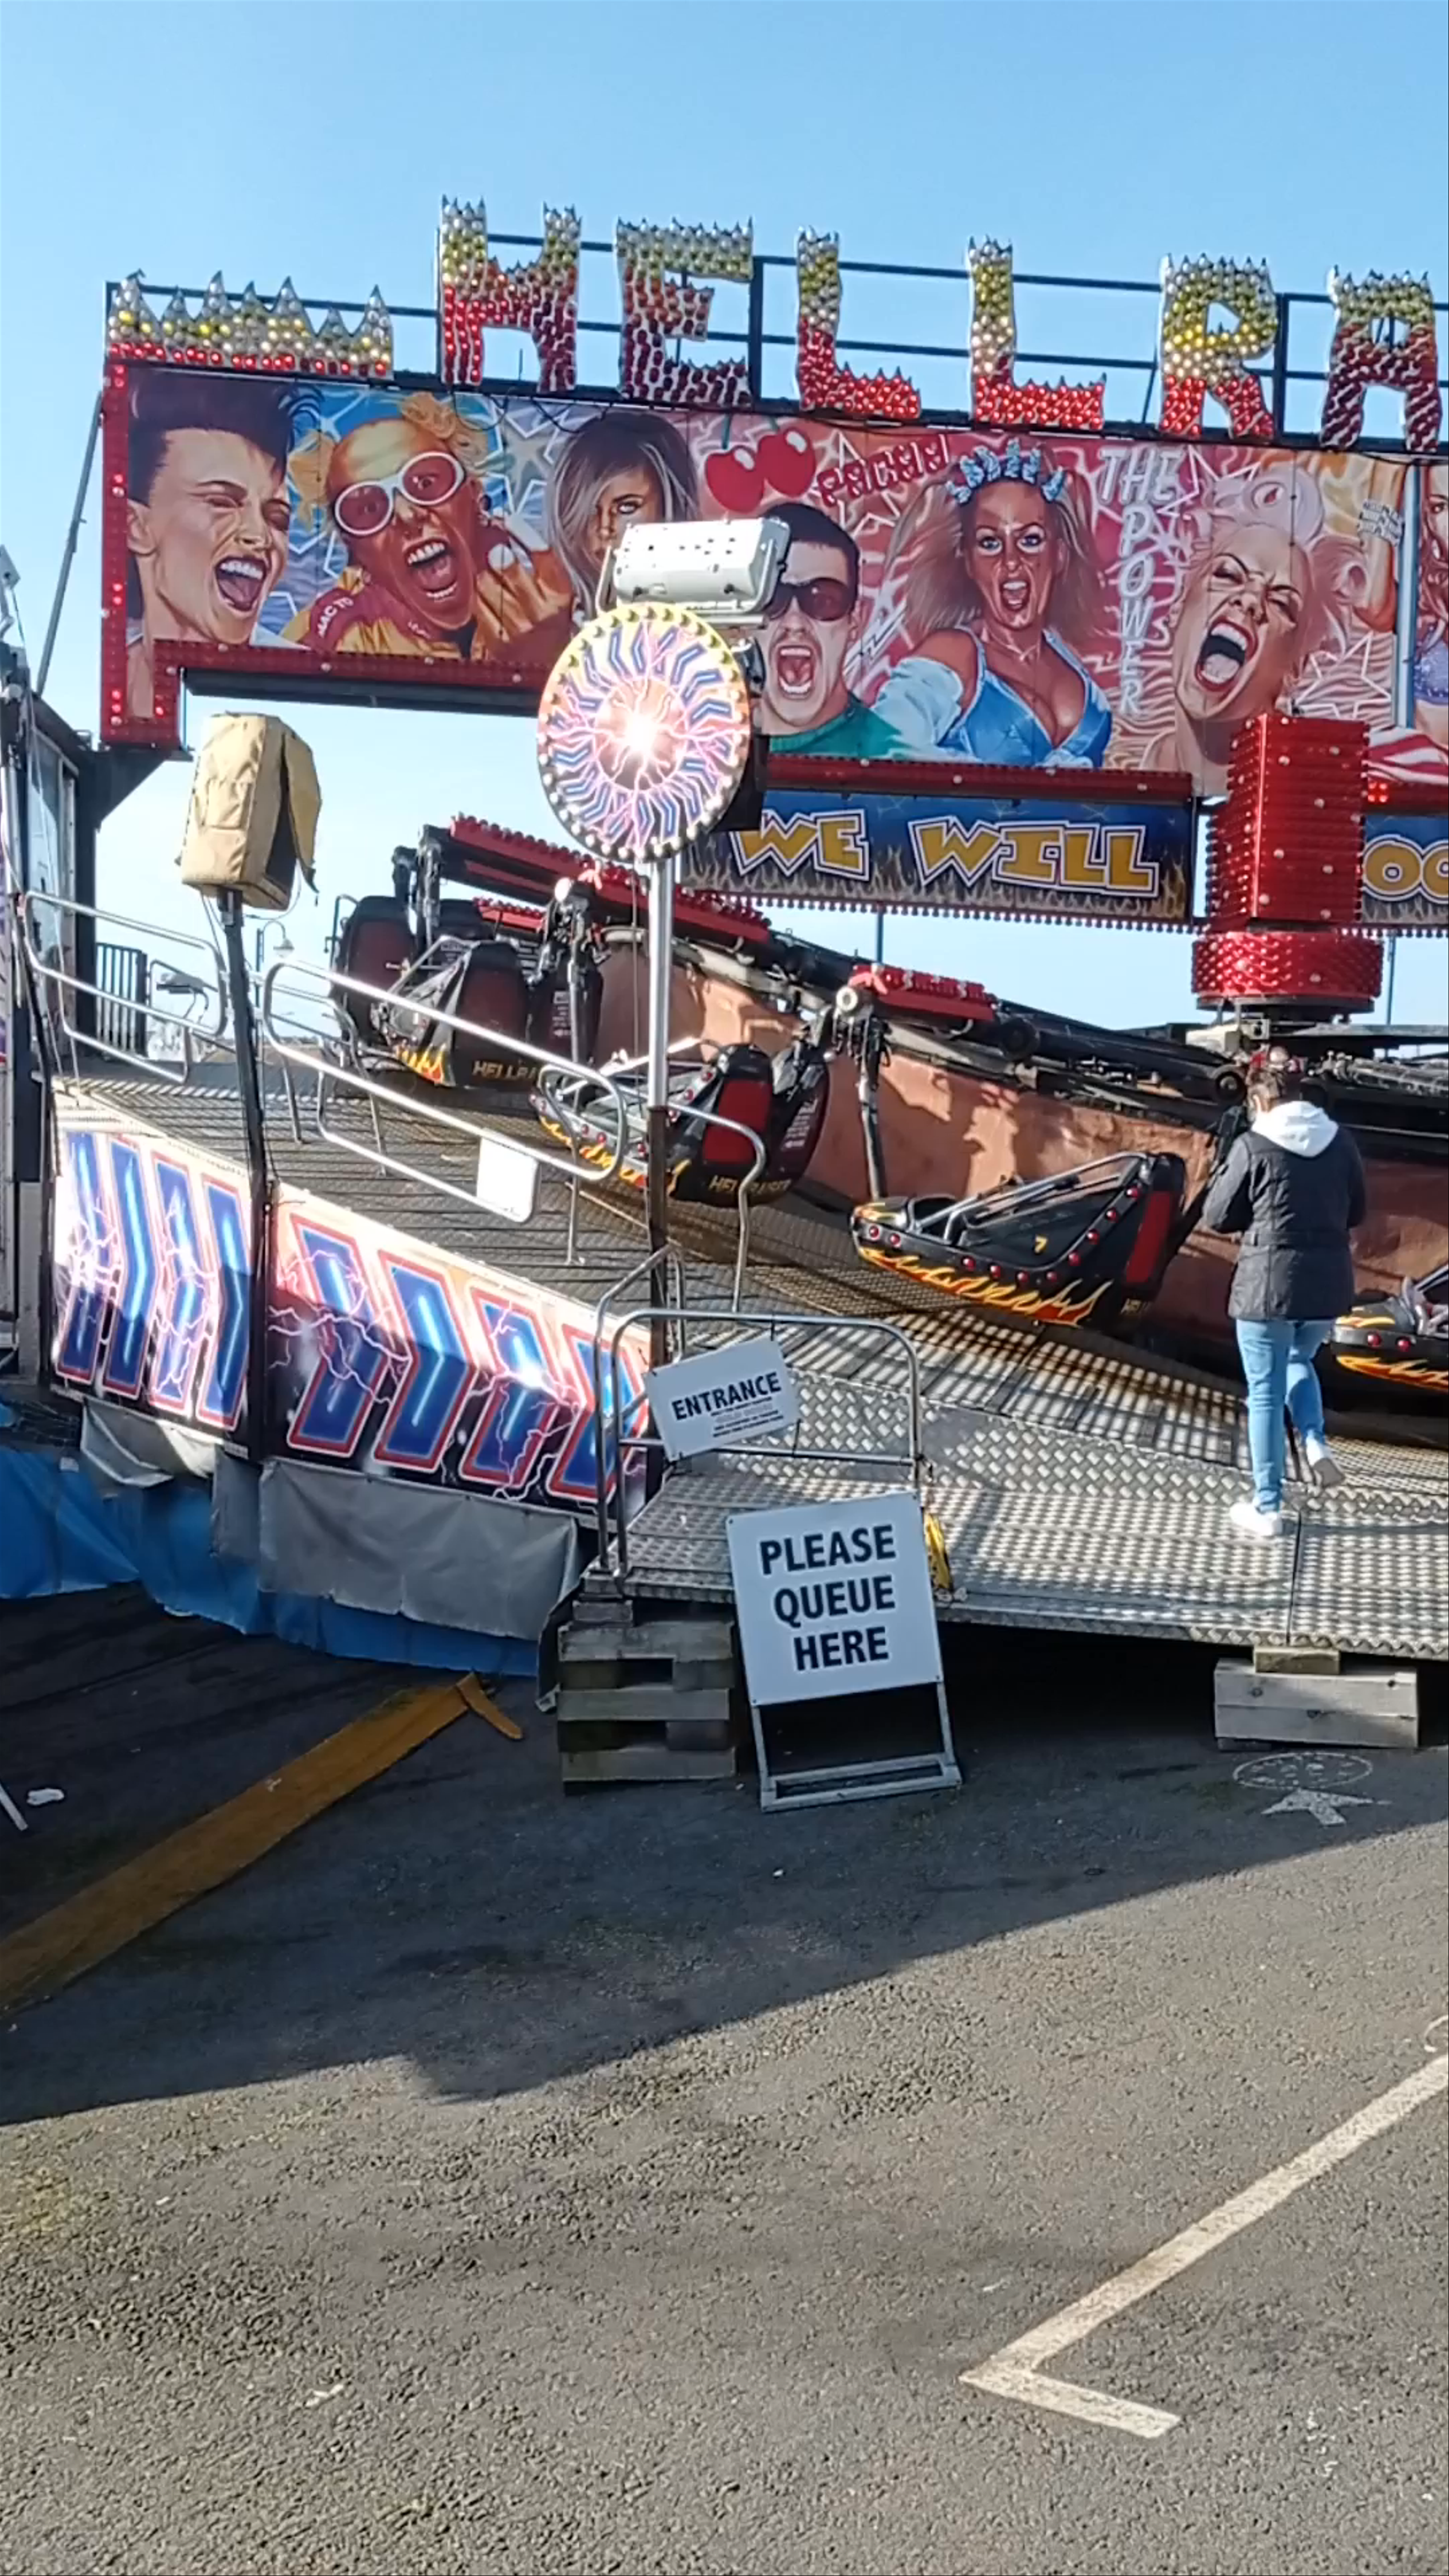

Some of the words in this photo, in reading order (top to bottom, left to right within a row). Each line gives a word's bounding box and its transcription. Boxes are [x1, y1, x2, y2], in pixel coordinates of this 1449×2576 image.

[1099, 447, 1184, 504] THE
[1118, 504, 1154, 716] POWER
[731, 807, 869, 882] WE
[908, 815, 1160, 898] WILL
[1035, 1235, 1048, 1253] 7
[671, 1371, 782, 1421] ENTRANCE
[760, 1524, 897, 1576] PLEASE
[774, 1575, 896, 1627] QUEUE
[794, 1626, 889, 1672] HERE
